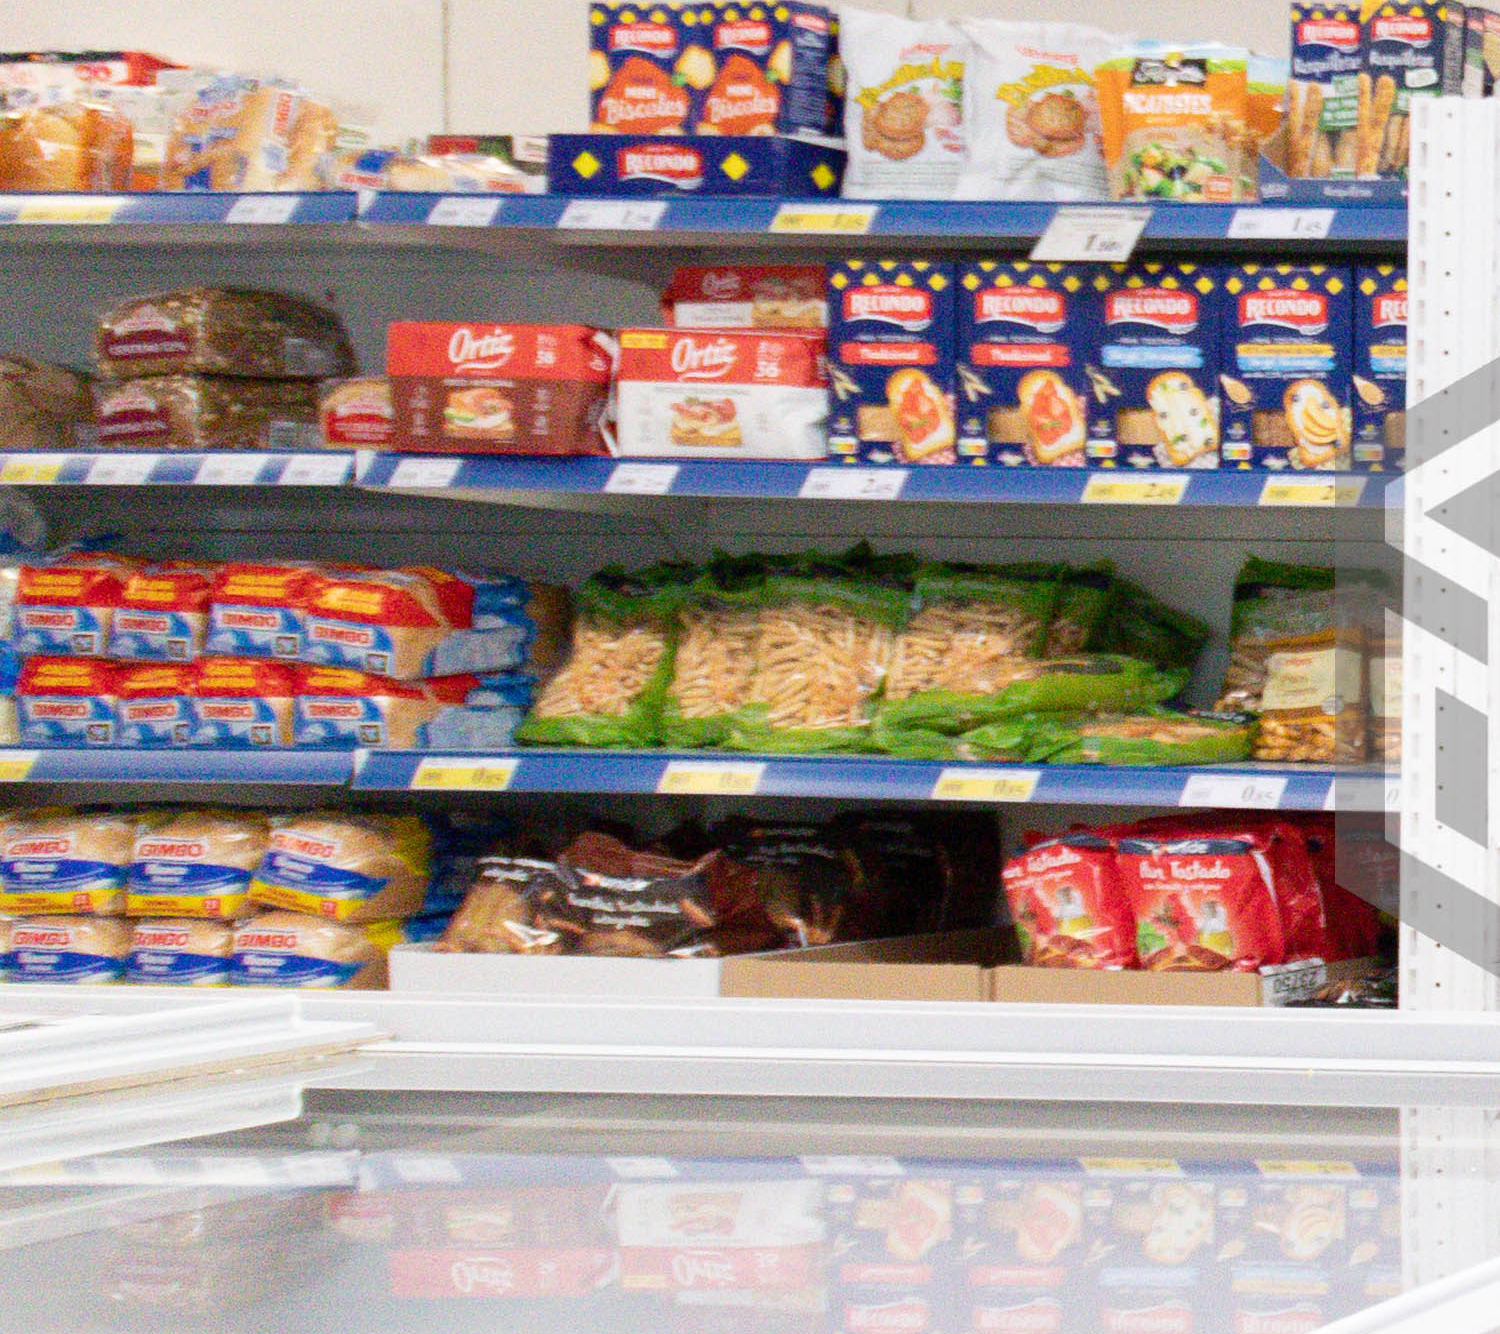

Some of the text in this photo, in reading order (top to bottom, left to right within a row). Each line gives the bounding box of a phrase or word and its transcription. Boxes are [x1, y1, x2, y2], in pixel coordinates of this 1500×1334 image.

[851, 295, 925, 314] RECONDO
[983, 295, 1058, 314] RECONDO
[1114, 298, 1190, 317] RECONDO
[1247, 298, 1321, 317] RECONDO
